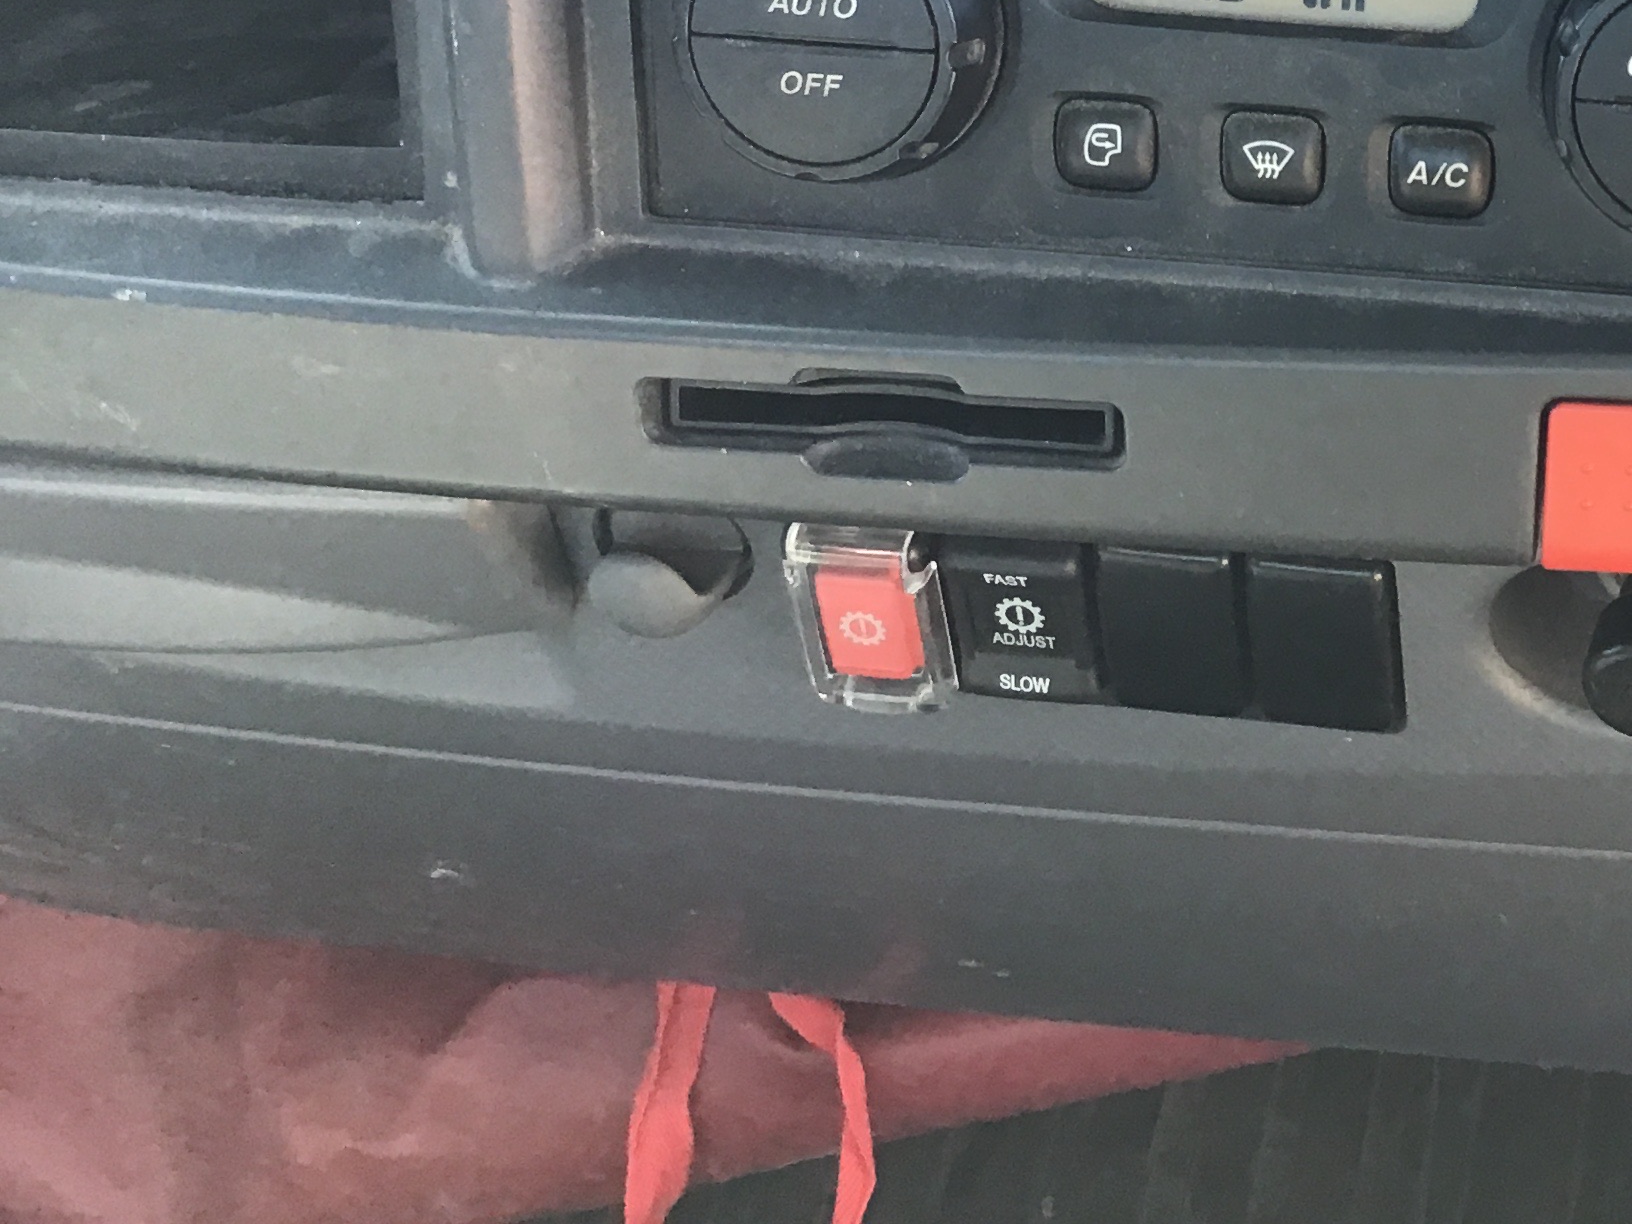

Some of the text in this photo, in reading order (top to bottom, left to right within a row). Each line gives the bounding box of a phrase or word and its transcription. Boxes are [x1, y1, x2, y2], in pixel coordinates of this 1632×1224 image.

[780, 70, 844, 97] OFF
[1407, 160, 1470, 188] A/C
[982, 573, 1028, 587] FAST
[992, 631, 1056, 650] ADJUST
[999, 673, 1050, 694] SLOW
